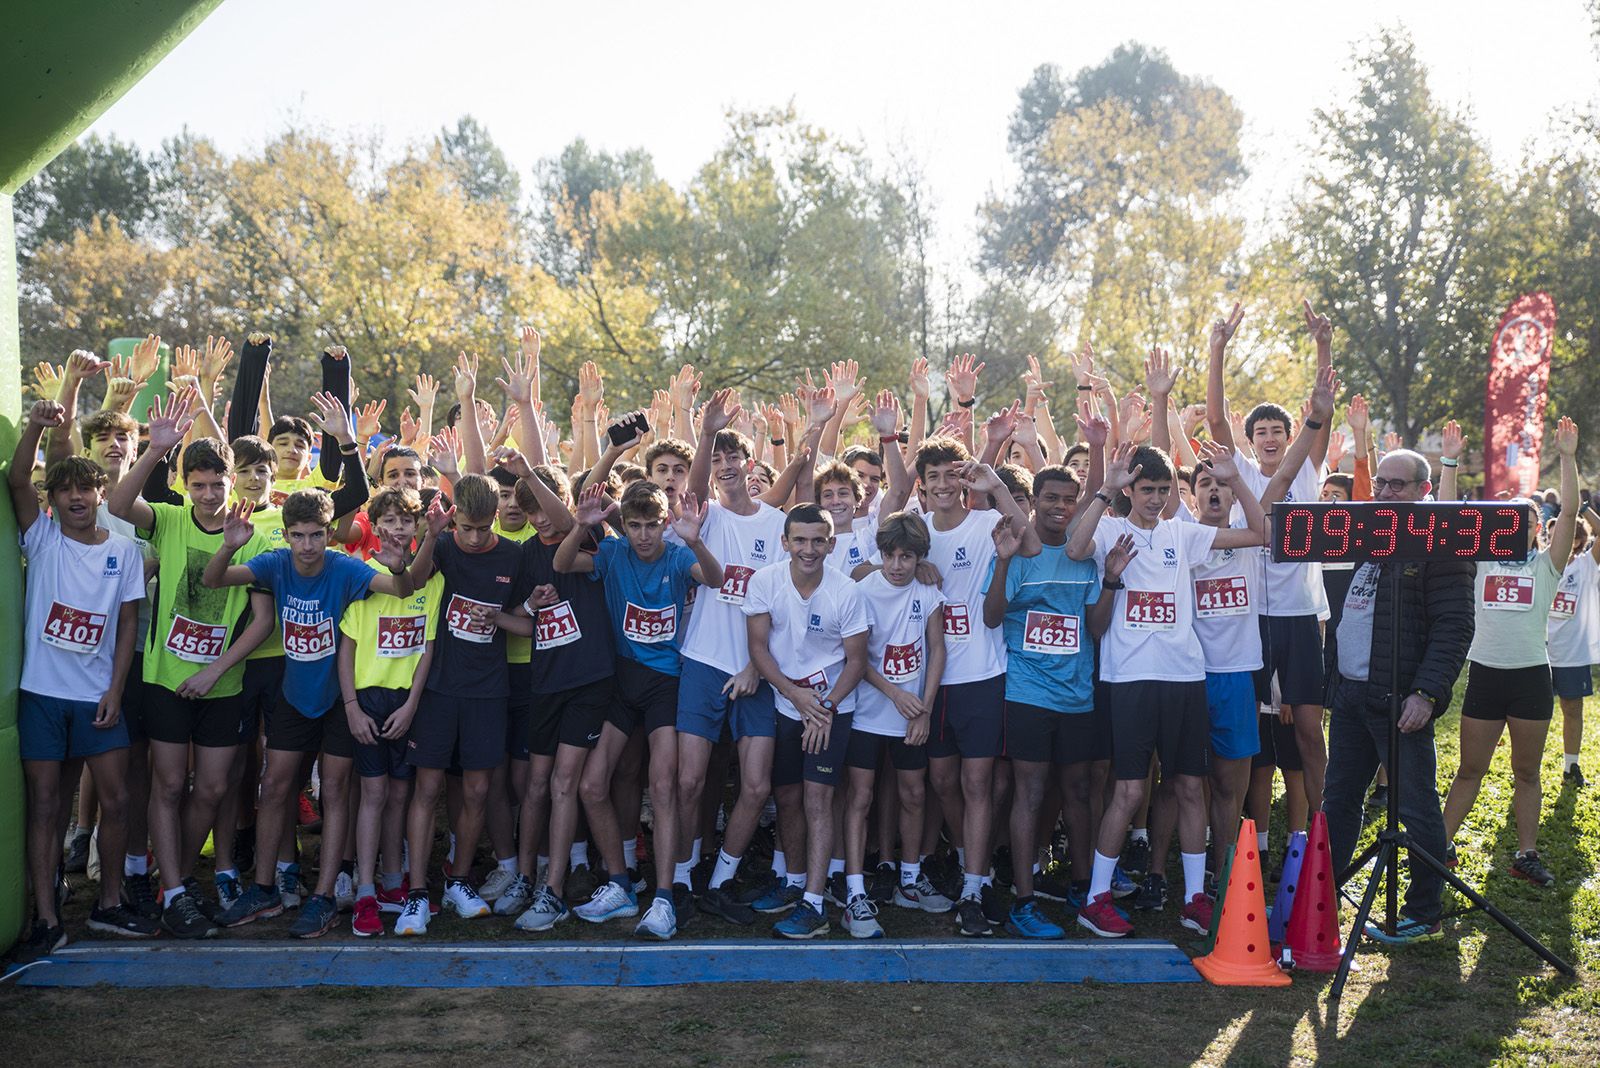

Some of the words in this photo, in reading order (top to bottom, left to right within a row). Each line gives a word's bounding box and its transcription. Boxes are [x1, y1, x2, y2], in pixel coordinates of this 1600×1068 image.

[1283, 509, 1520, 556] 09:34:32
[750, 551, 767, 560] VIARÓ
[952, 560, 972, 568] VIARÓ
[1199, 590, 1247, 609] 4118
[1496, 587, 1519, 602] 85
[1128, 604, 1175, 623] 4135
[48, 618, 99, 645] 4101
[628, 618, 674, 636] 1594
[943, 618, 968, 634] 15
[171, 632, 222, 655] 4567
[287, 632, 332, 653] 4504
[381, 628, 423, 648] 2674
[1028, 626, 1077, 647] 4625
